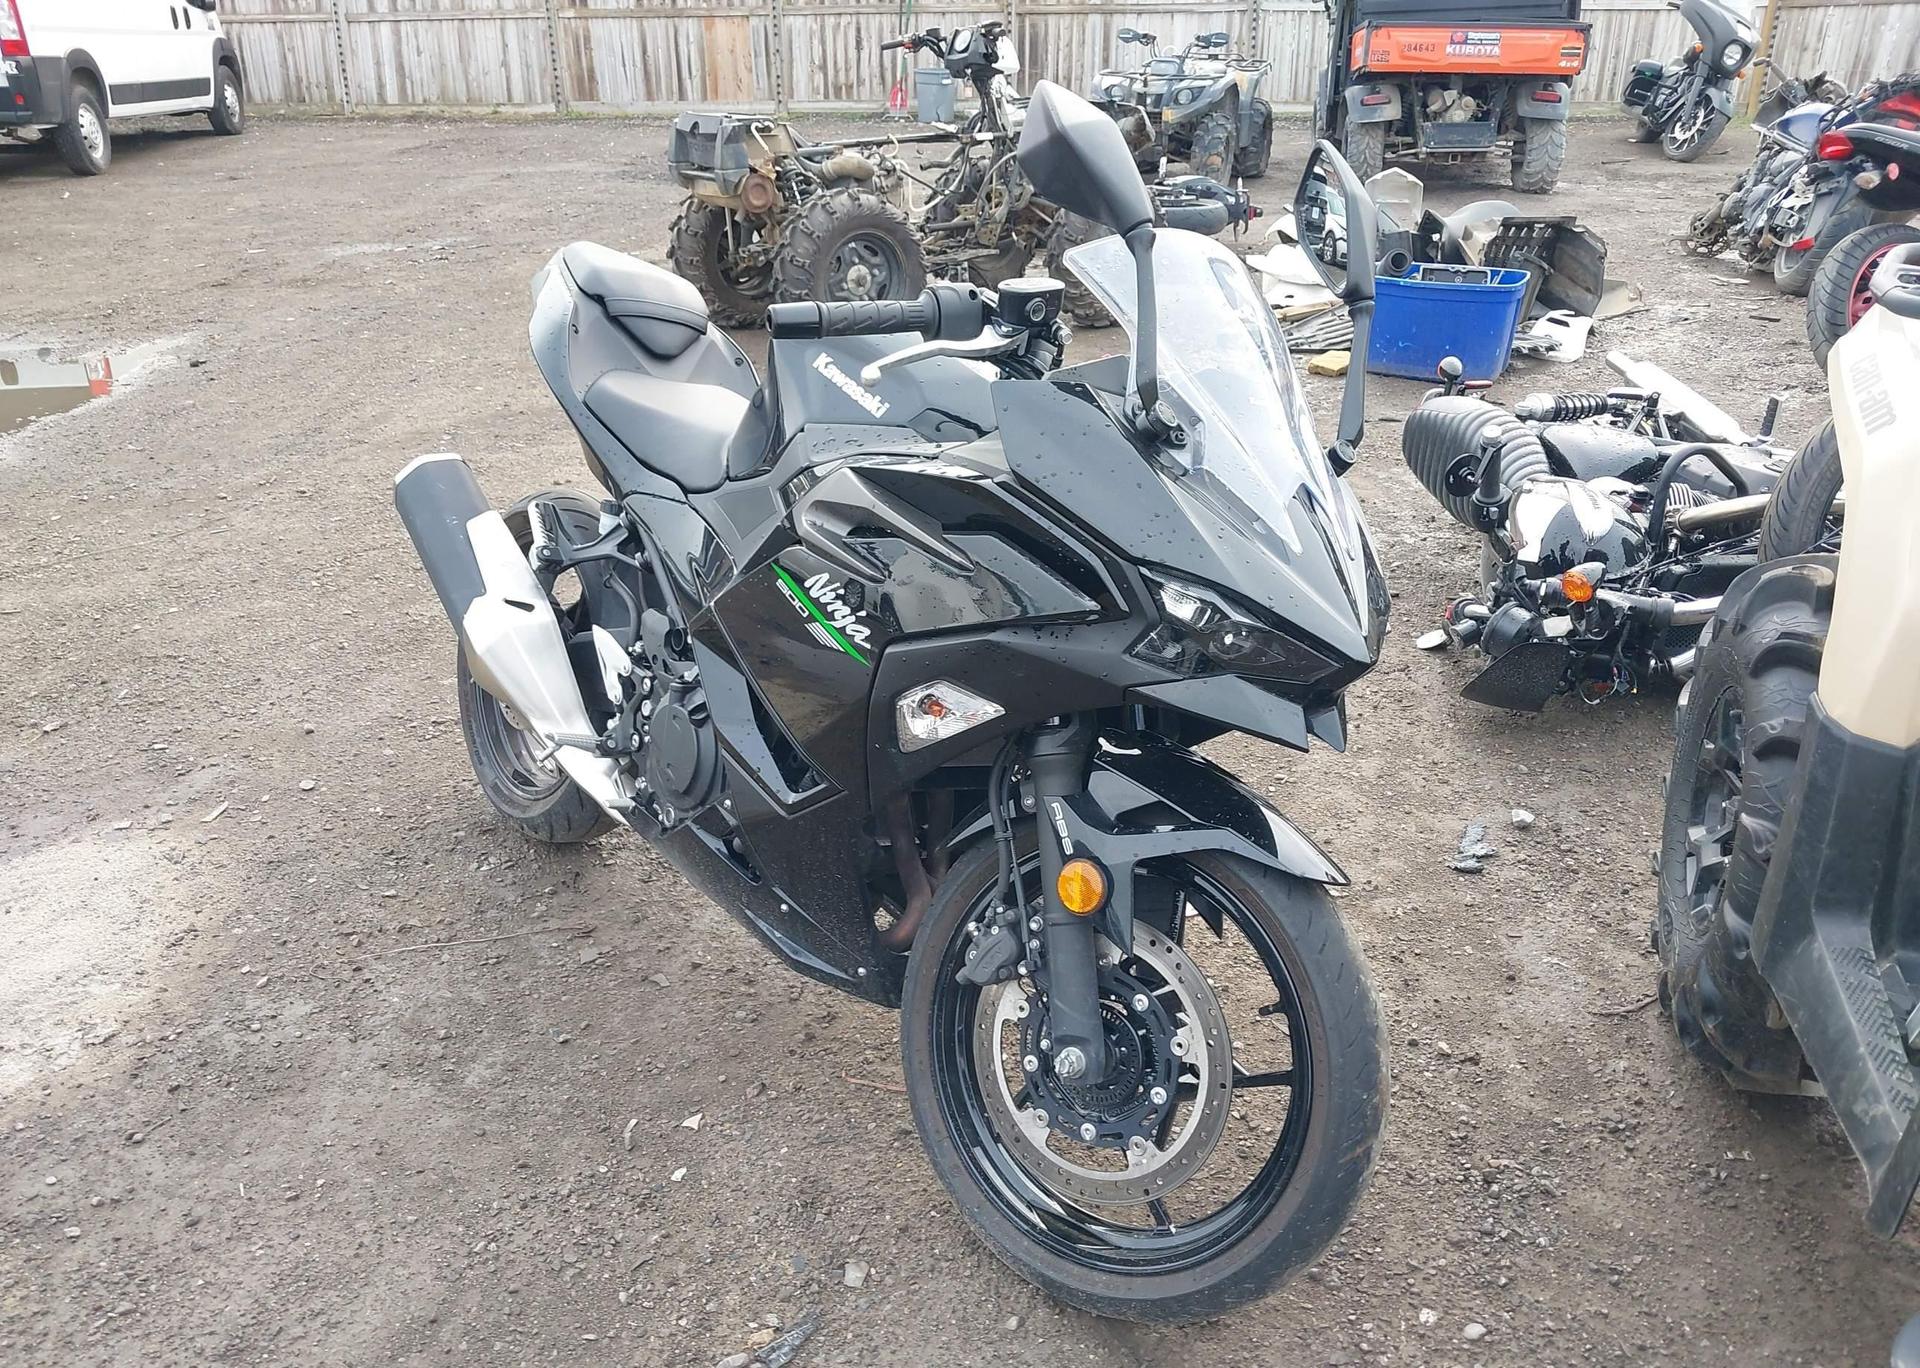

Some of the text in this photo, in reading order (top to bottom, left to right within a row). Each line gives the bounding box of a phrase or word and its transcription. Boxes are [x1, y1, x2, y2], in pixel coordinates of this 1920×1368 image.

[1446, 44, 1500, 57] KUBOTA
[1558, 60, 1580, 69] 4x4
[812, 351, 890, 419] Kawasaki
[775, 578, 809, 618] 500
[803, 572, 871, 649] Ninja
[1050, 802, 1074, 855] ABS
